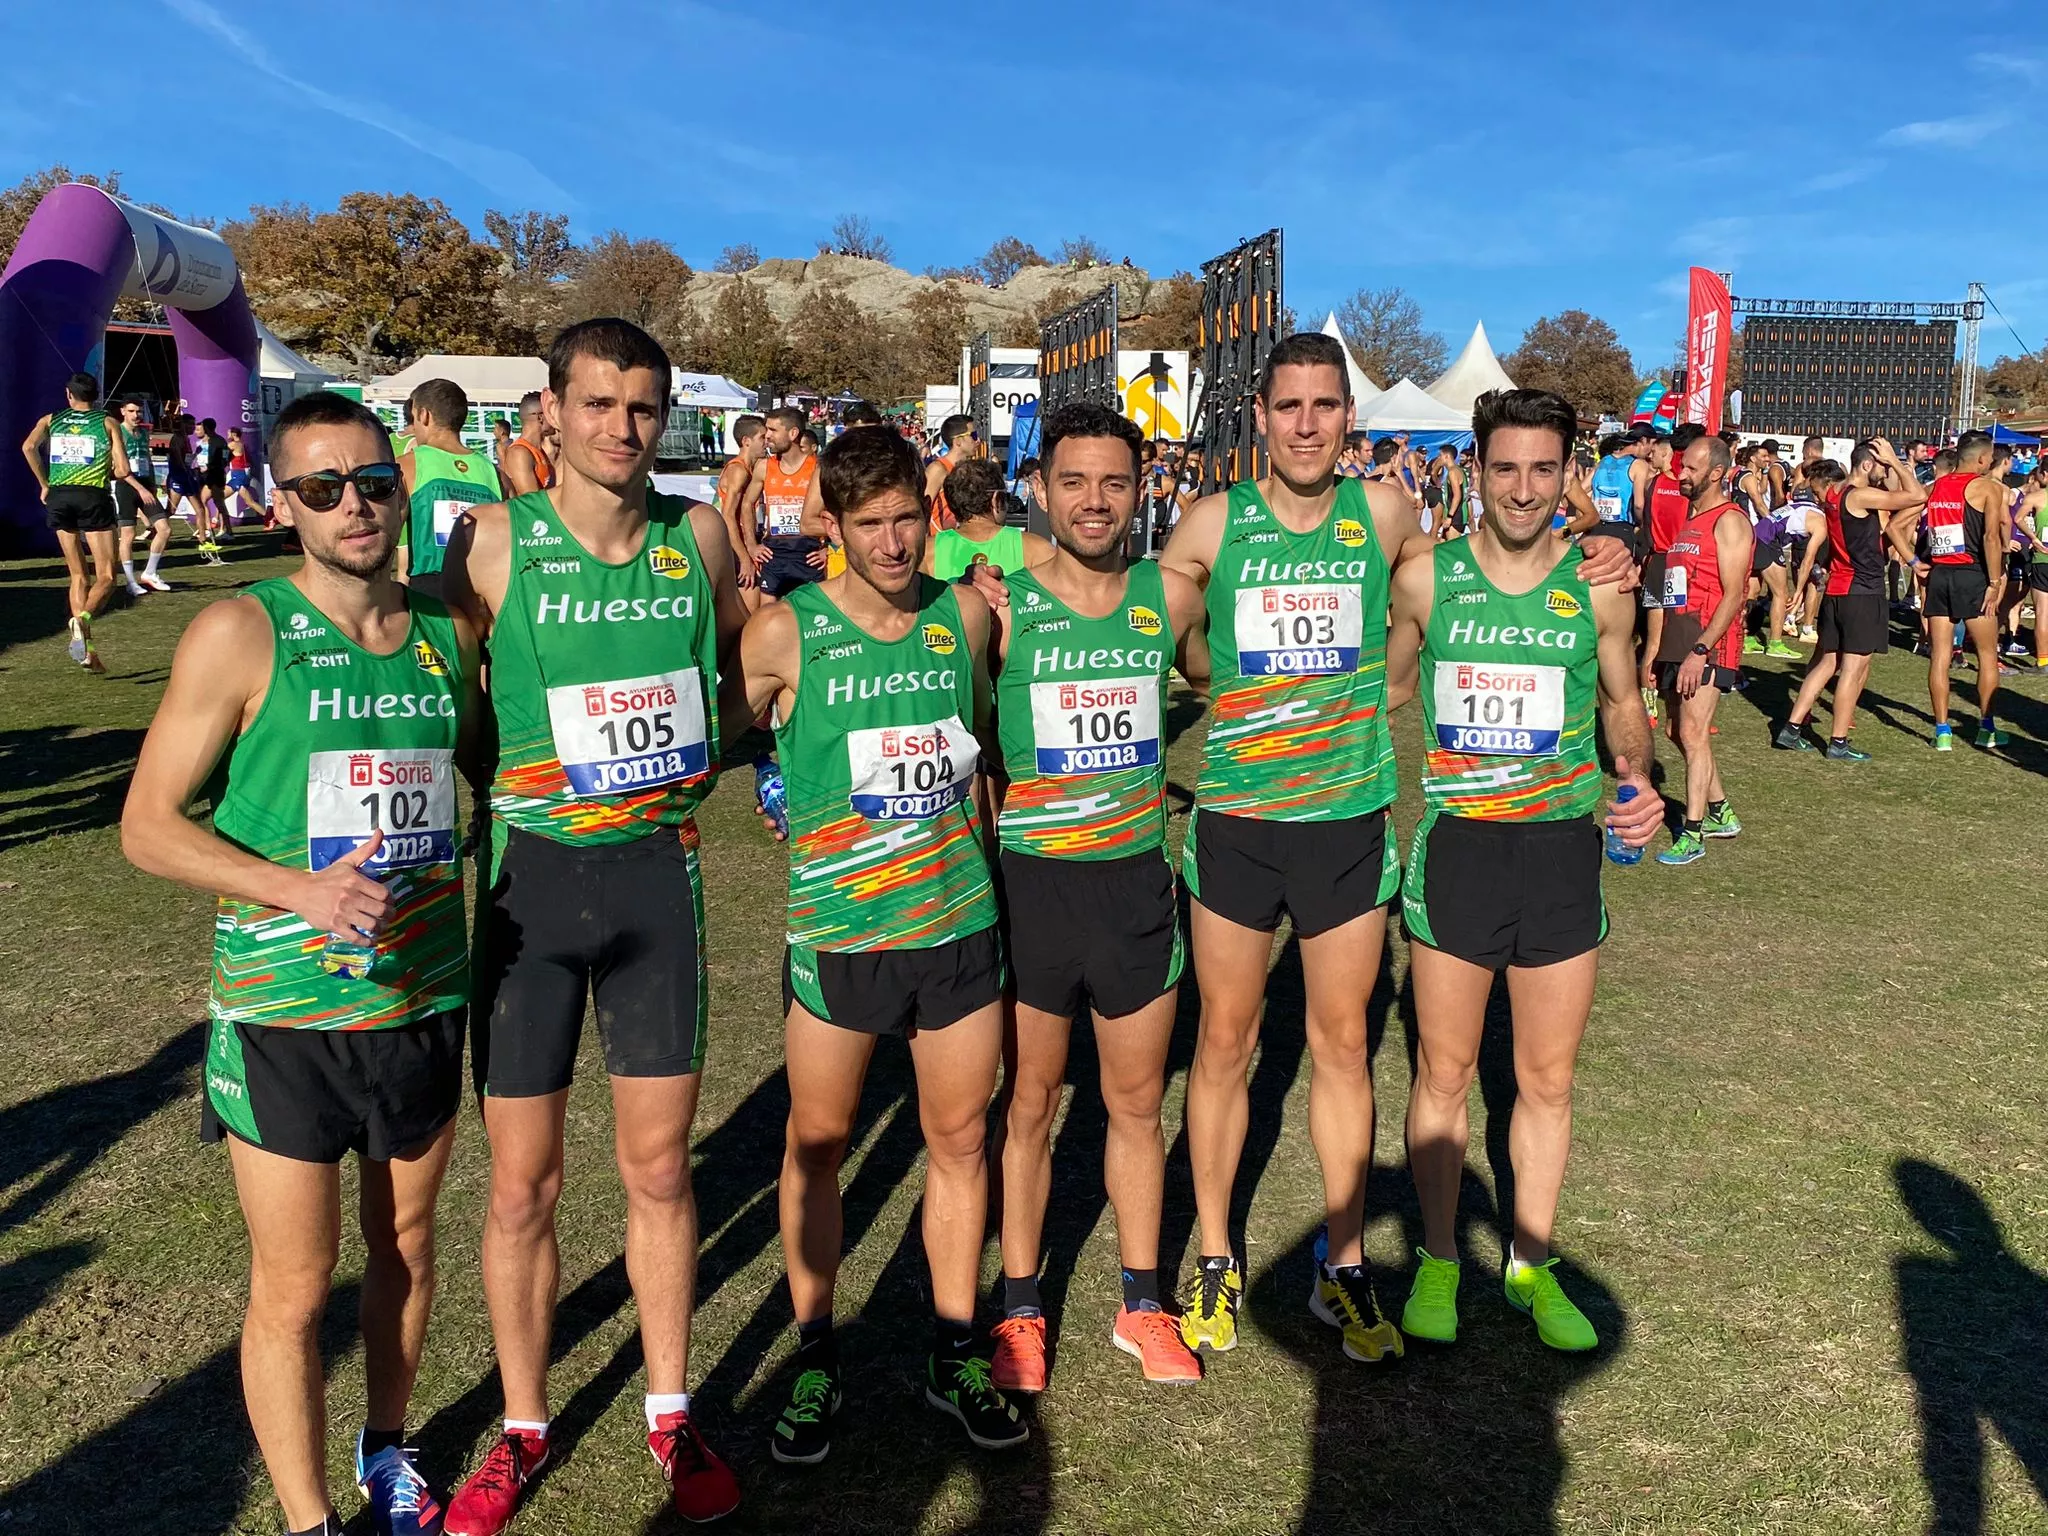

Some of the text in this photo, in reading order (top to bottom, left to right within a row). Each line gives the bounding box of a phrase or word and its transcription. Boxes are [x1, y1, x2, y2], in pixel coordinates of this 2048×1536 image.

[62, 446, 83, 456] 256
[779, 514, 800, 526] 325
[1233, 515, 1267, 525] VIATOR
[519, 537, 562, 547] VIATOR
[1249, 534, 1279, 544] ZOITI
[541, 555, 581, 563] ATLETISMO
[542, 562, 580, 574] ZOITI
[1239, 558, 1367, 583] Huesca
[1443, 573, 1475, 583] VIATOR
[536, 593, 693, 624] Huesca
[1018, 602, 1053, 615] VIATOR
[1283, 593, 1339, 611] Soria
[1458, 593, 1488, 605] ZOITI
[280, 627, 327, 640] VIATOR
[803, 624, 843, 640] VIATOR
[1038, 620, 1071, 634] ZOITI
[1270, 615, 1335, 646] 103
[1448, 619, 1577, 650] Huesca
[308, 646, 349, 656] ATLETISMO
[311, 653, 351, 668] ZOITI
[829, 644, 863, 661] ZOITI
[1033, 646, 1163, 677] Huesca
[826, 669, 956, 706] Huesca
[1475, 672, 1536, 692] Soria
[308, 688, 457, 722] Huesca
[610, 688, 678, 713] Soria
[1080, 689, 1138, 709] Soria
[1462, 694, 1524, 726] 101
[598, 711, 675, 756] 105
[1068, 710, 1133, 744] 106
[377, 761, 433, 786] Soria
[890, 754, 956, 792] 104
[360, 790, 429, 831] 102
[1406, 828, 1424, 887] Huesca
